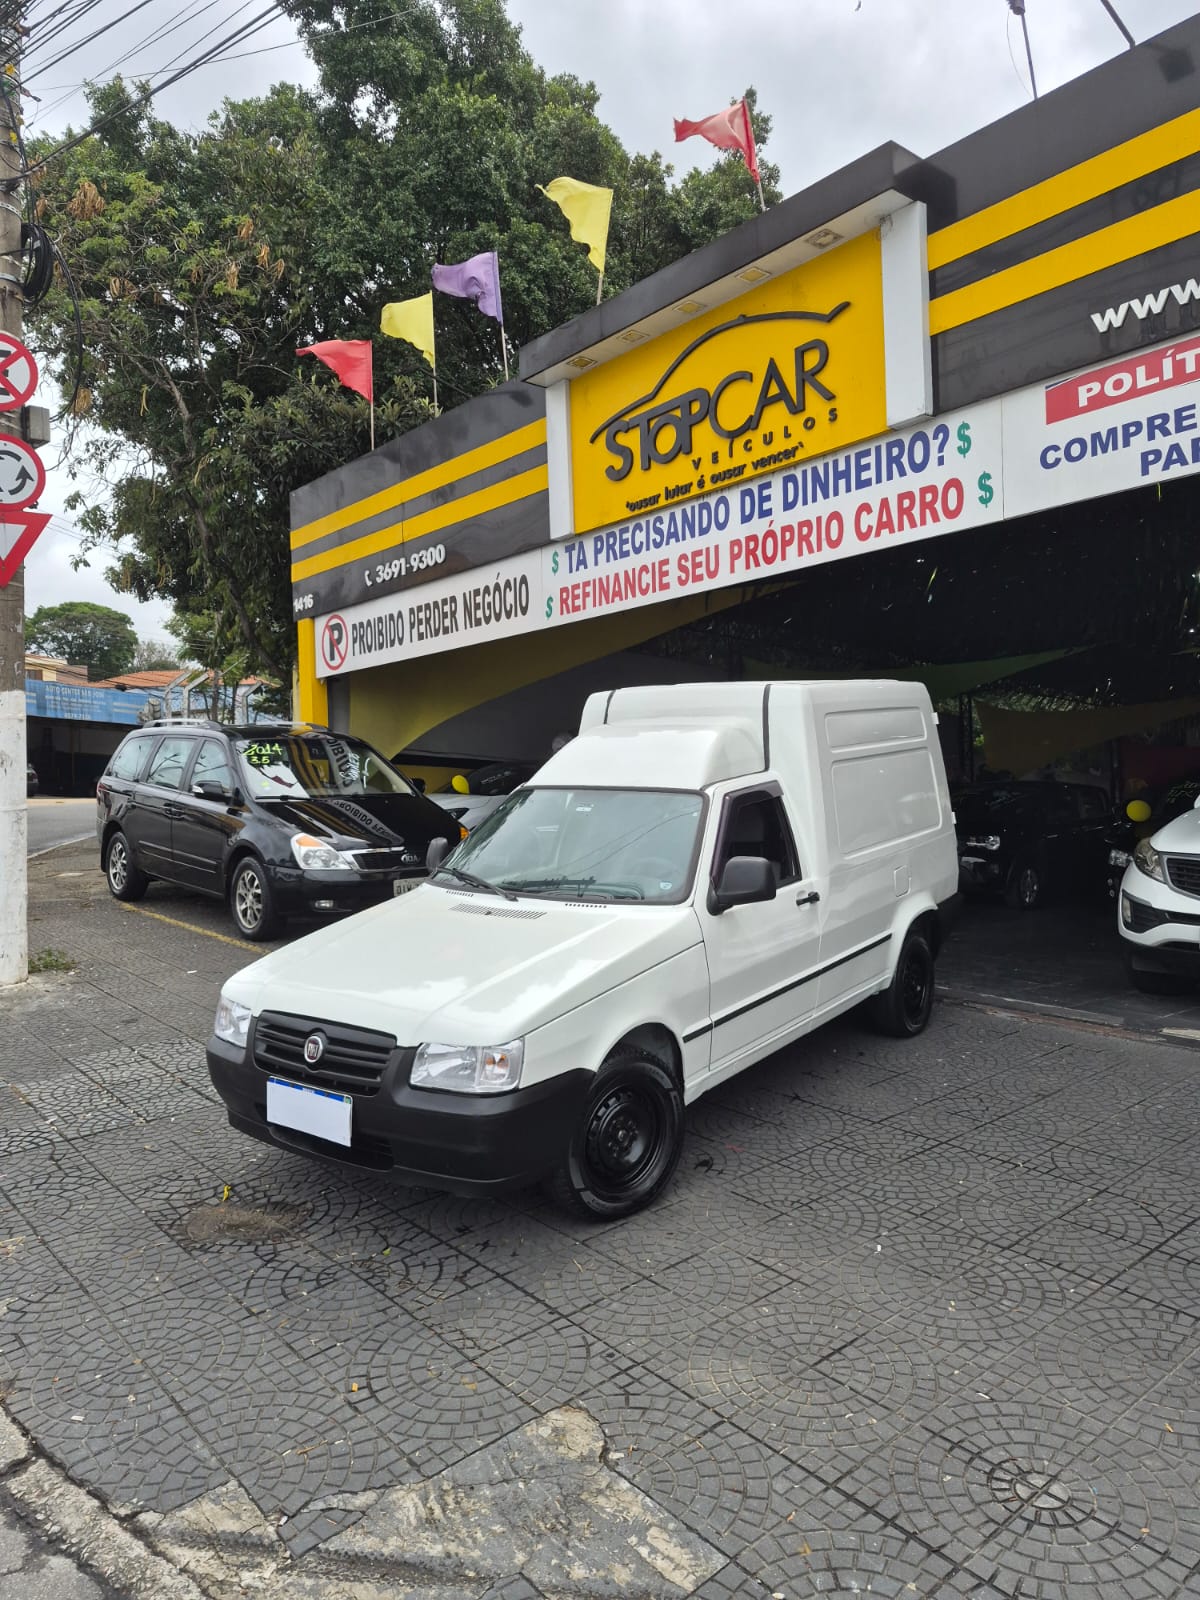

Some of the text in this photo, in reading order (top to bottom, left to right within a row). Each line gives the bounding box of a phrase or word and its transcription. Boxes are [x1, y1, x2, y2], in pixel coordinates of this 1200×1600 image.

[692, 408, 838, 470] VEÍCULOS
[1040, 403, 1197, 470] COMPRE
[552, 421, 971, 576] $ TA PRECISANDO DE DINHEIRO? $
[665, 482, 693, 501] lutar
[697, 475, 705, 489] é
[710, 463, 747, 484] ousar
[375, 544, 446, 584] 3691-9300
[545, 471, 994, 620] $ REFINANCIE SEU PRÓPRIO CARRO $
[351, 610, 404, 656] PROIBIDO
[409, 595, 458, 643] PERDER
[463, 572, 529, 629] NEGÓCIO
[243, 743, 282, 756] 2014
